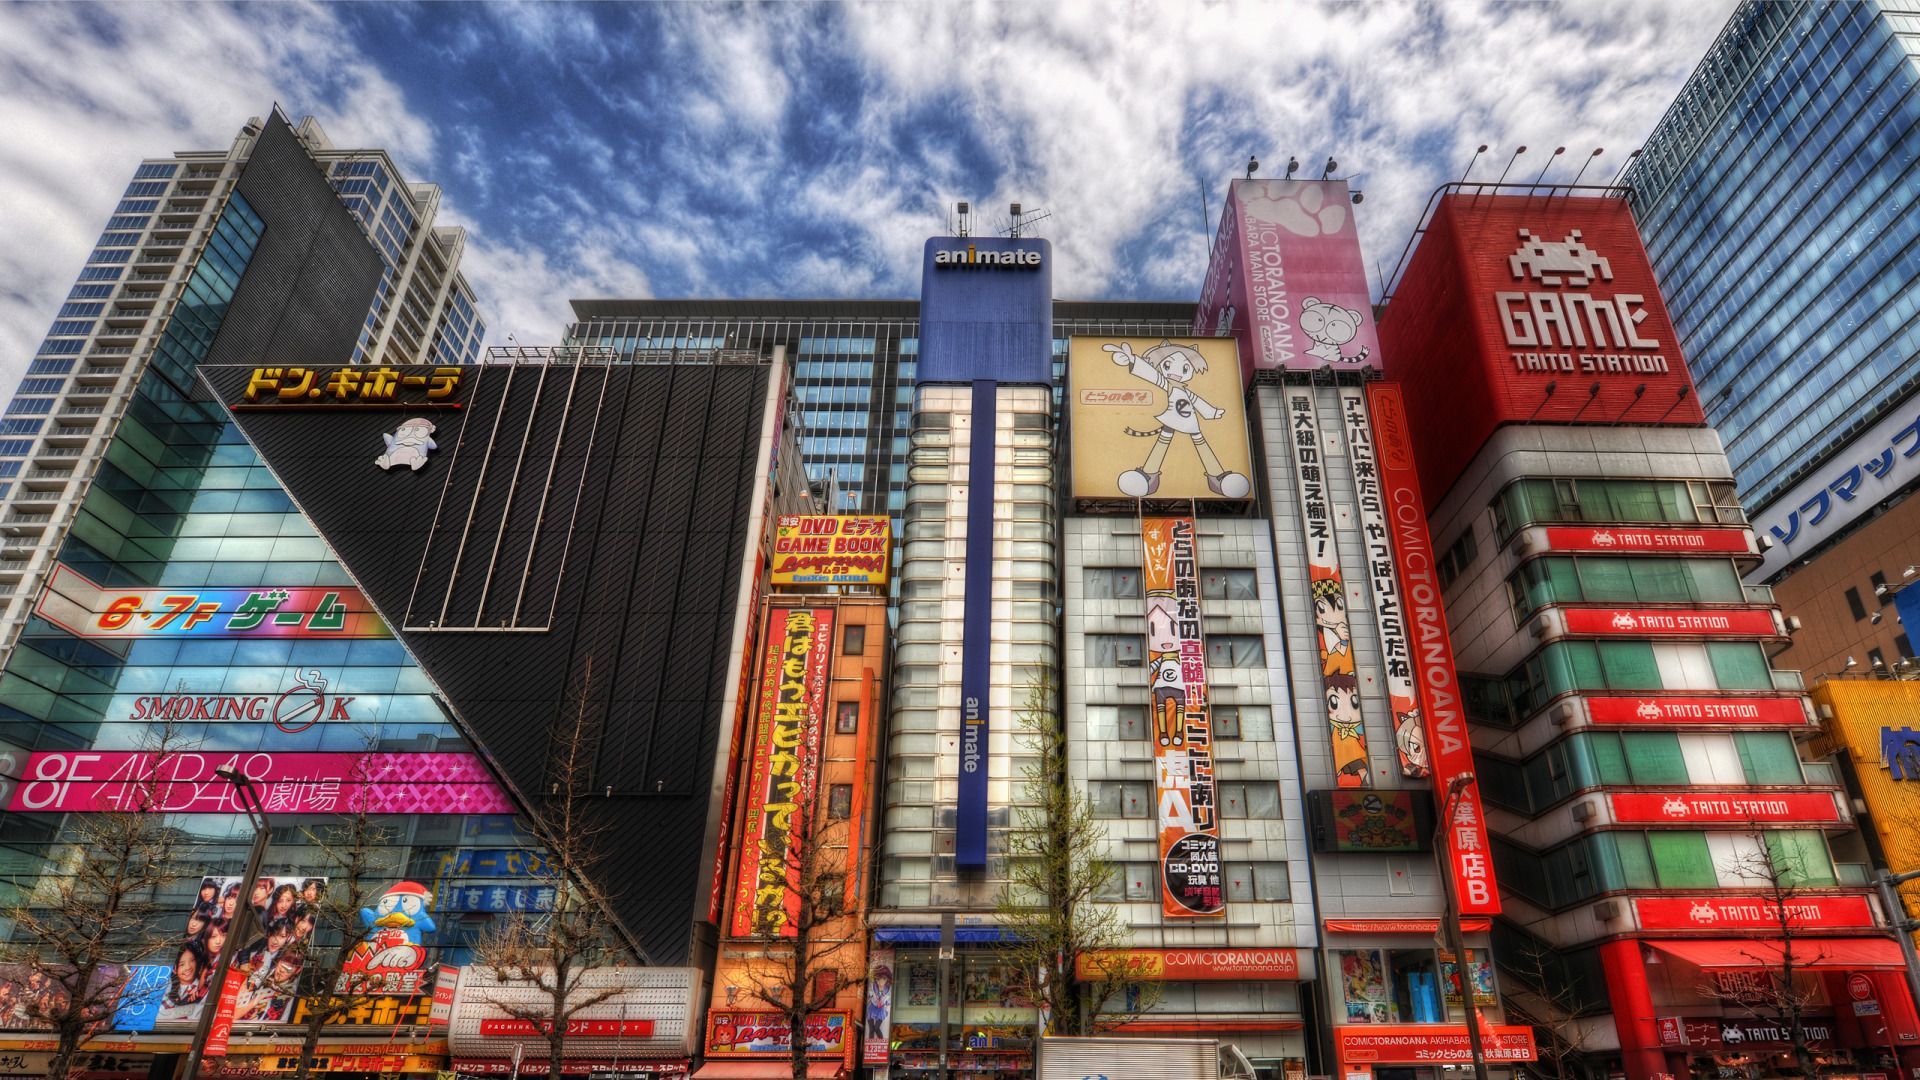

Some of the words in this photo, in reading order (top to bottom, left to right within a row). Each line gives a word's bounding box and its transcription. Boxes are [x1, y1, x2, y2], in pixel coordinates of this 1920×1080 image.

[936, 244, 1041, 264] animate
[1248, 250, 1265, 282] MAIN
[1253, 285, 1271, 321] STORE
[1495, 291, 1660, 348] GAME
[1512, 352, 1574, 372] TAITO
[1579, 353, 1669, 373] STATION
[1085, 391, 1148, 402] とらのあな
[799, 518, 839, 535] DVD
[841, 518, 888, 535] ビデオ
[776, 537, 831, 553] GAME
[833, 537, 886, 553] BOOK
[1617, 534, 1652, 545] TAITO
[1656, 534, 1704, 546] STATION
[224, 589, 348, 631] ゲーム
[1393, 487, 1463, 755] COMICTORANOANA
[1638, 616, 1675, 628] TAITO
[1680, 616, 1729, 629] STATION
[129, 696, 269, 720] SMOKING
[1664, 704, 1701, 717] TAITO
[1705, 704, 1758, 717] STATION
[964, 696, 985, 773] animate
[23, 752, 101, 809] 8F
[1691, 801, 1729, 815] TAITO
[1733, 801, 1789, 815] STATION
[1181, 840, 1216, 850] コミック
[1190, 851, 1218, 862] 同人誌
[1187, 875, 1207, 885] 玩具
[1210, 875, 1220, 885] 他
[1719, 905, 1759, 920] TAITO
[1165, 952, 1294, 965] COMICTORANOANA
[1745, 1027, 1779, 1040] TAITO
[1344, 1036, 1427, 1046] COMICTORANOANA
[1429, 1036, 1471, 1045] AKIHABAR
[1503, 1036, 1528, 1045] STORE
[342, 1043, 407, 1056] AMUSEMENT
[1415, 1049, 1473, 1059] コミックとらのあ
[453, 1063, 485, 1072] パチンコ
[622, 1064, 654, 1072] パチンコ
